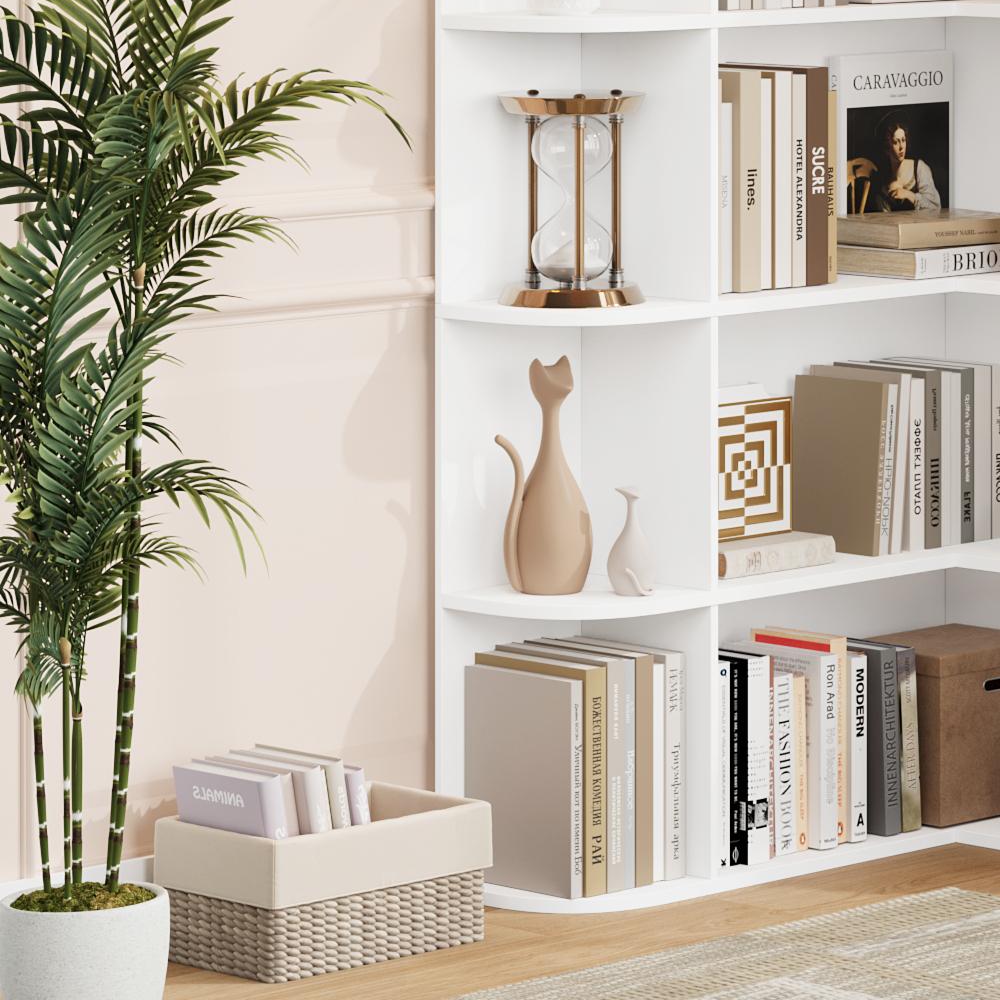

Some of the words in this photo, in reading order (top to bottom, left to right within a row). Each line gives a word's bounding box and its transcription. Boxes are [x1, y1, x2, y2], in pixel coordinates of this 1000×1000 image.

[853, 70, 944, 91] CARAVAGGIO
[747, 168, 757, 210] lines.
[811, 146, 825, 195] SUCRE
[778, 678, 790, 716] THE
[826, 664, 835, 688] Ron
[826, 692, 835, 720] Arad
[856, 668, 865, 737] MODERN
[592, 696, 602, 776] БОЖЕСТВЕННАЯ
[883, 660, 899, 808] INNENARCHITEKTUR
[574, 744, 582, 788] Уличный
[779, 720, 792, 796] FASHION
[592, 778, 602, 826] КОМЕДИЯ
[671, 742, 680, 830] Триумфальная
[672, 834, 680, 860] арка
[780, 800, 792, 850] BOOK
[592, 835, 604, 865] РАЙ
